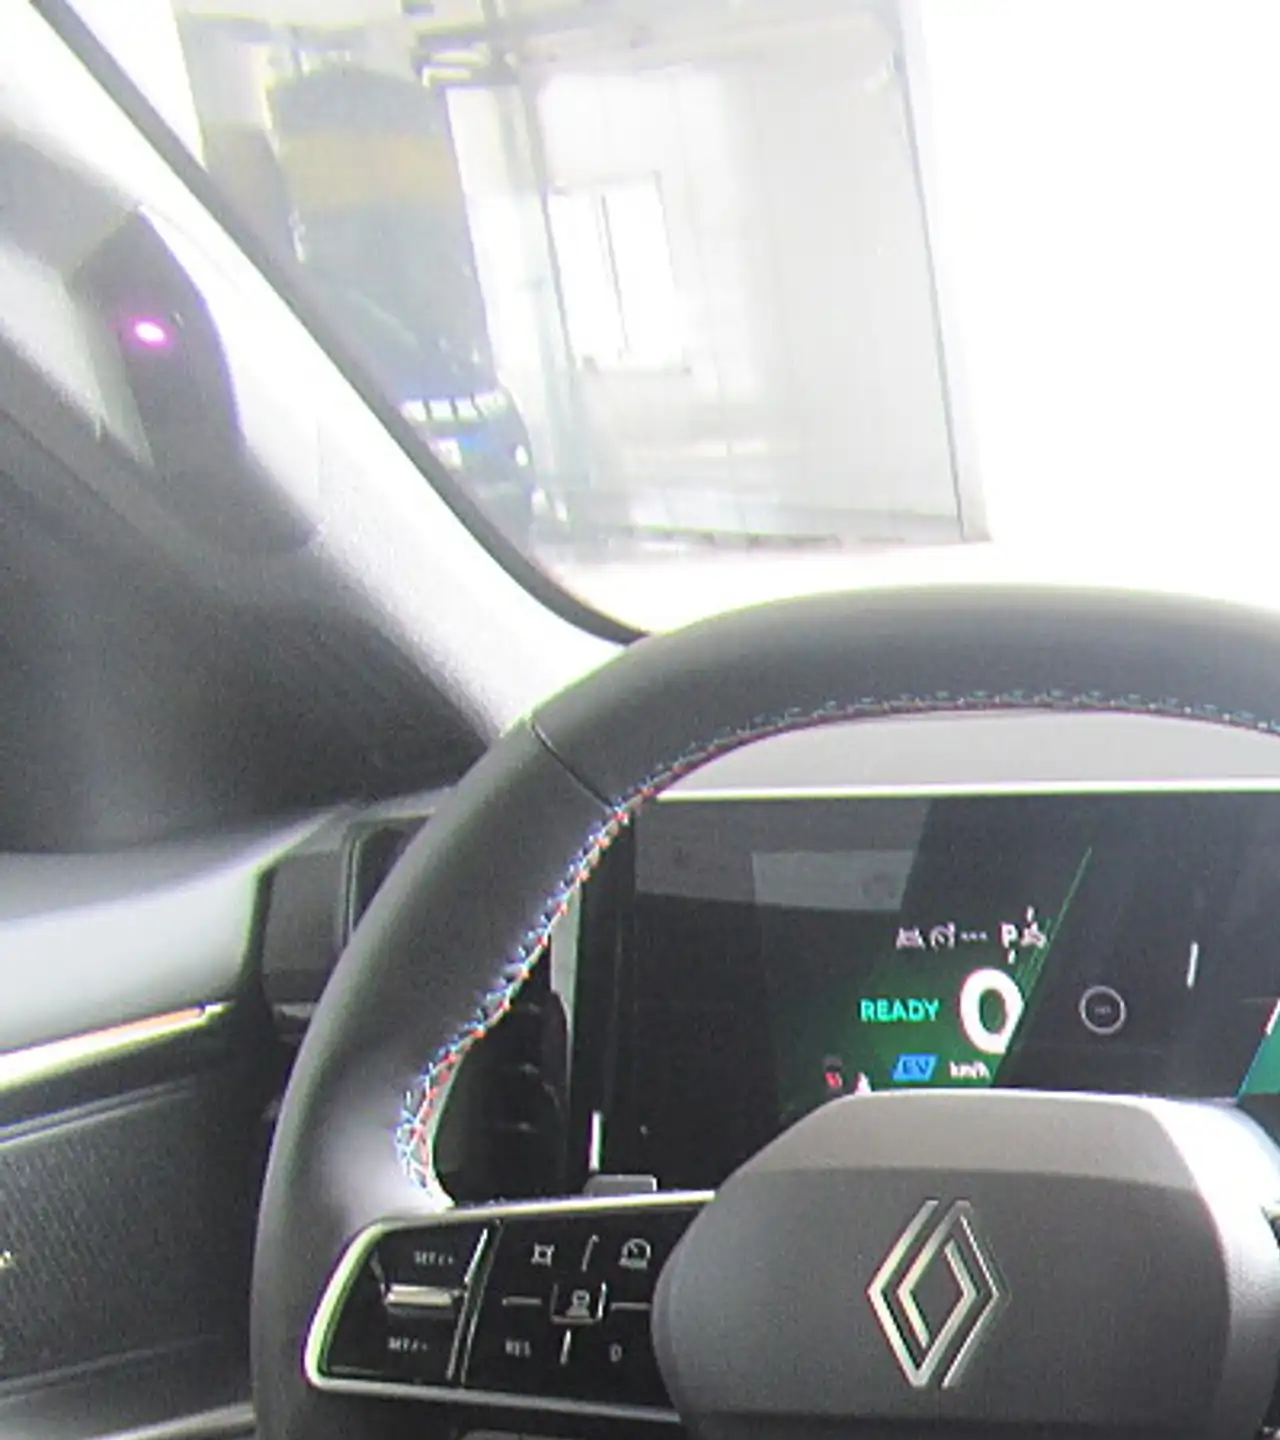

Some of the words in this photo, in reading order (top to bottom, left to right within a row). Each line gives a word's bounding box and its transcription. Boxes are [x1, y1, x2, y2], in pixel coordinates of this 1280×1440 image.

[860, 999, 939, 1022] READY
[961, 968, 1024, 1054] 0
[901, 1058, 931, 1076] EV
